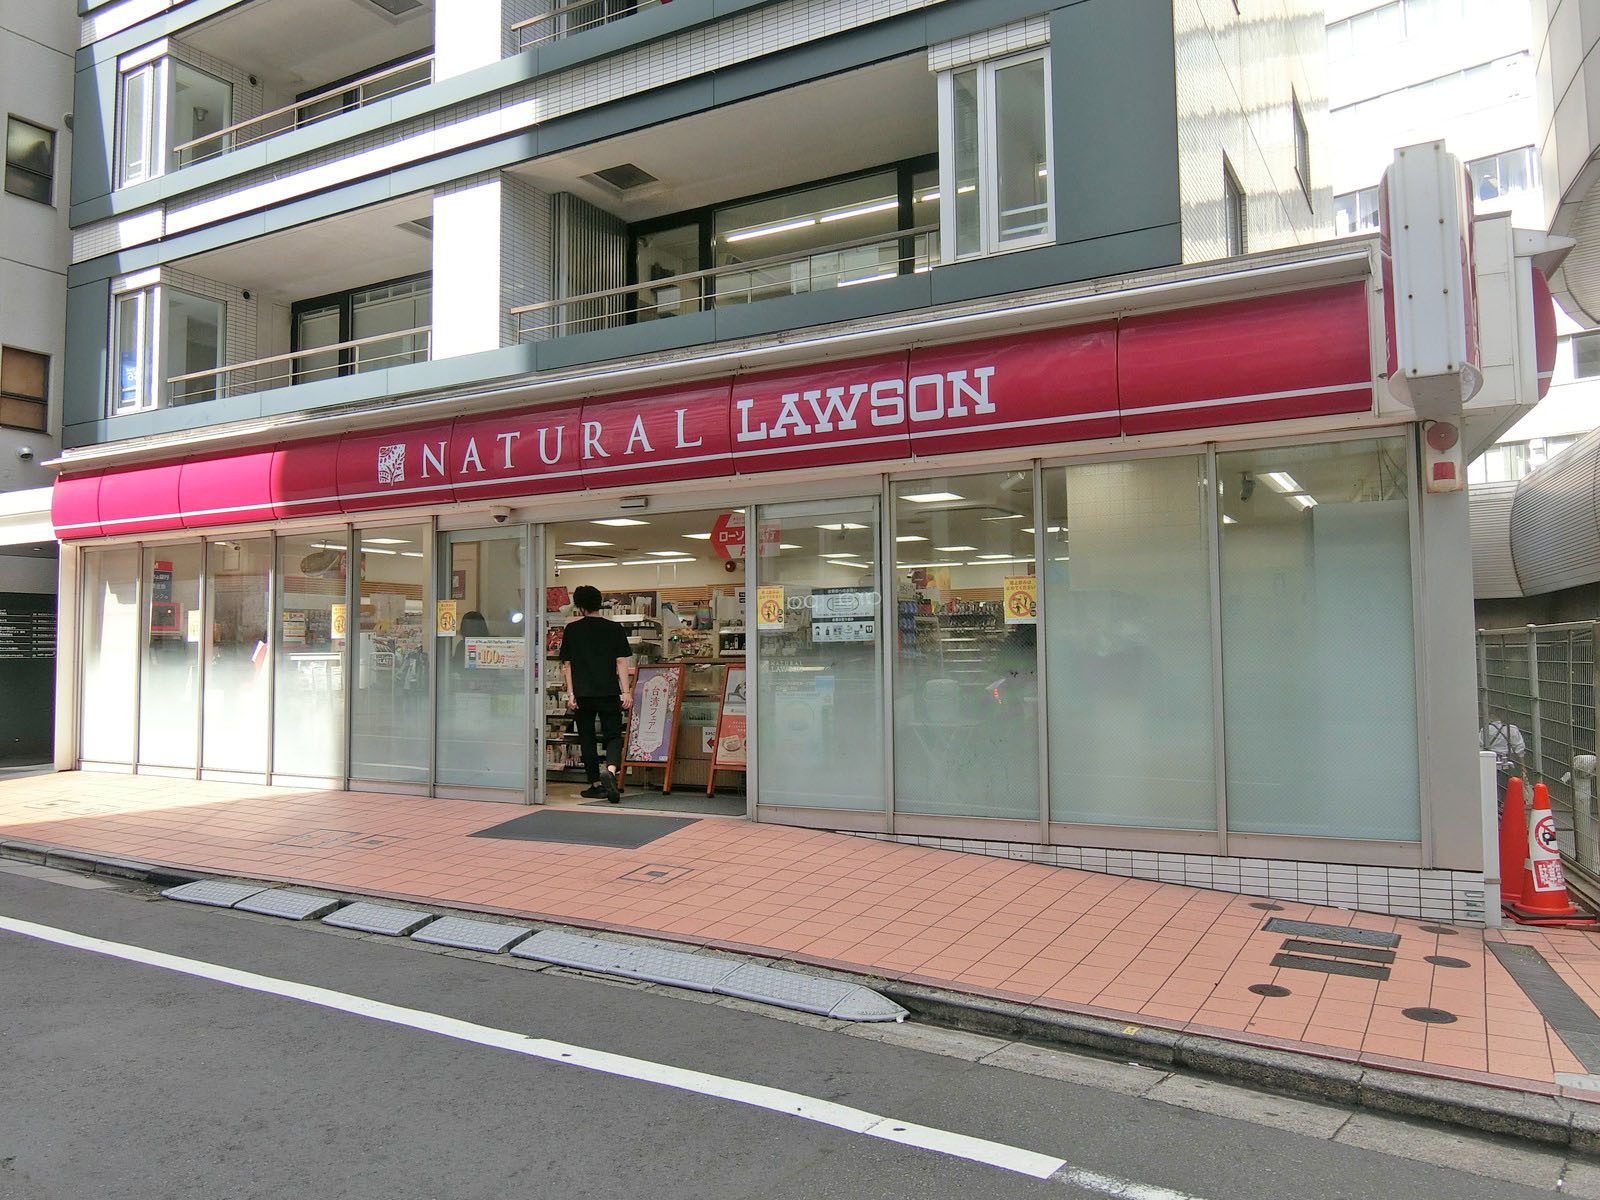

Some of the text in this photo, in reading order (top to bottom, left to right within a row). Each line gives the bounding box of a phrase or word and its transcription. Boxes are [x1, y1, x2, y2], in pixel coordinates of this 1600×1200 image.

[421, 366, 996, 478] NATURAL LAWSON
[649, 686, 661, 730] 台湾フェア
